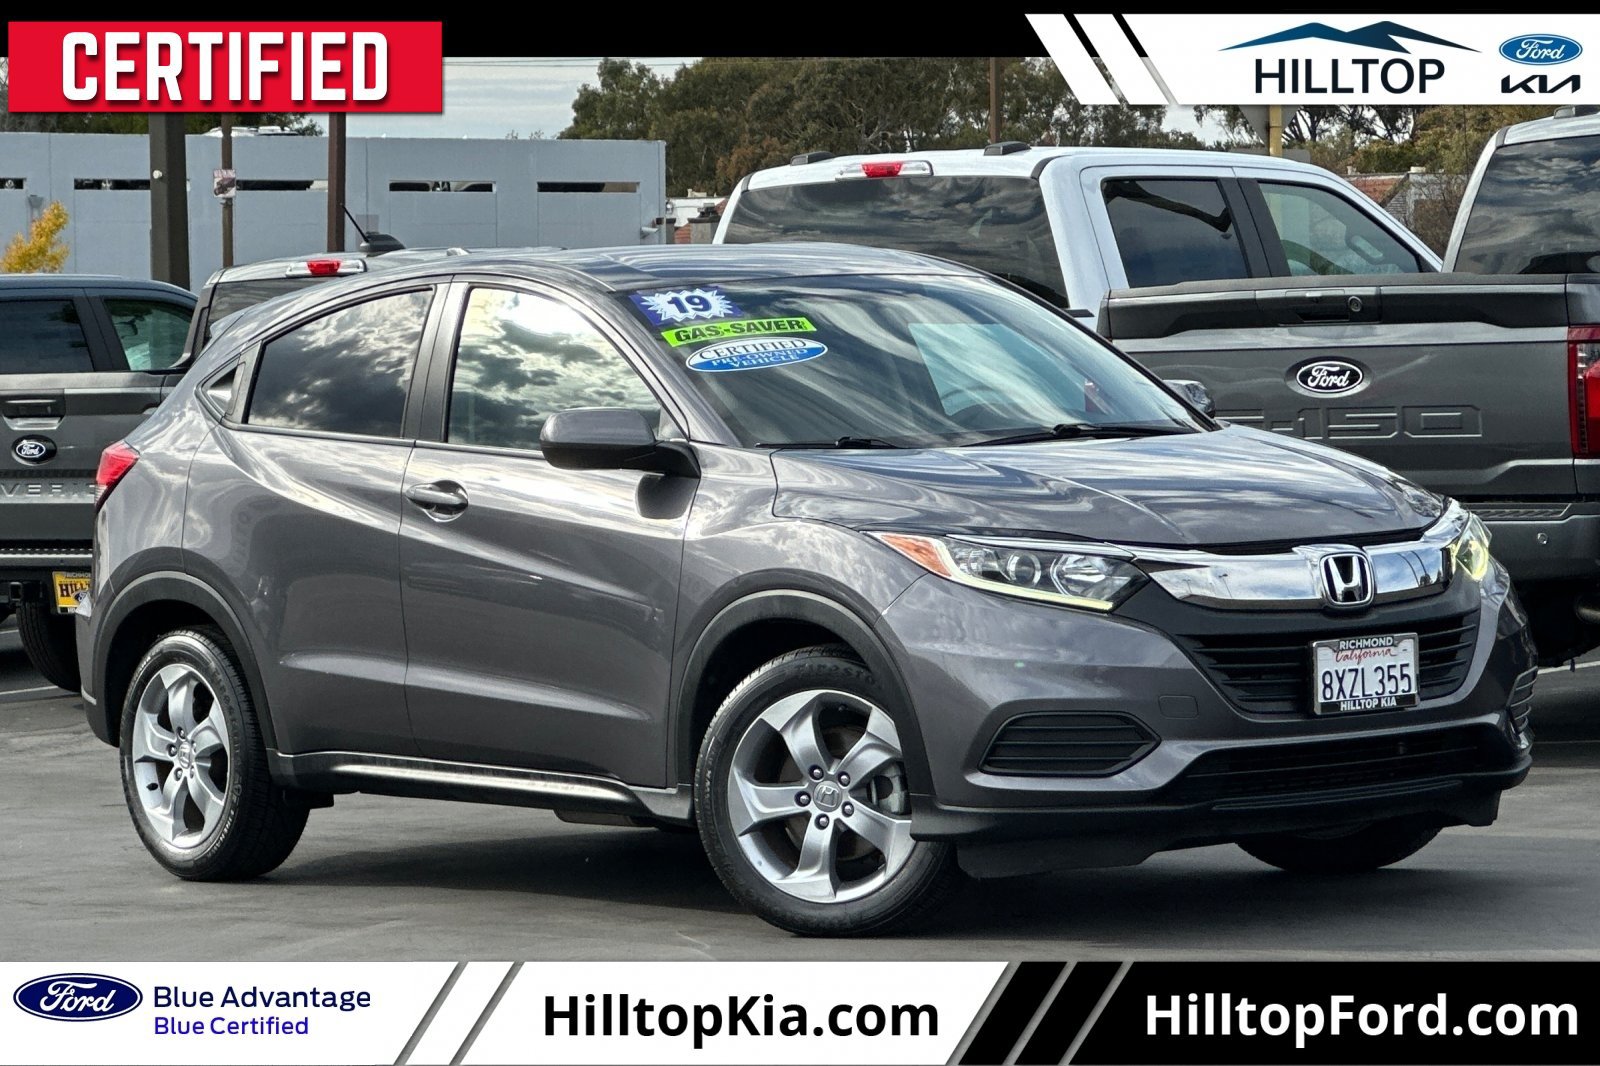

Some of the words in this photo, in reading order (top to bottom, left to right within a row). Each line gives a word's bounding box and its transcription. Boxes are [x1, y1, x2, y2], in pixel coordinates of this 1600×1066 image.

[667, 294, 713, 314] 19
[674, 319, 803, 343] GAS-SAVER
[699, 339, 807, 361] CERTIFIED
[711, 348, 809, 367] PRE-OWNED
[729, 355, 800, 369] VEHICLE
[1307, 366, 1350, 388] Ford
[21, 443, 40, 455] Ford
[1340, 636, 1393, 650] RICHMOND
[1335, 648, 1397, 665] California
[1321, 663, 1412, 701] 8XZL355
[1340, 698, 1379, 711] HILLTOP
[1381, 696, 1397, 707] KIA
